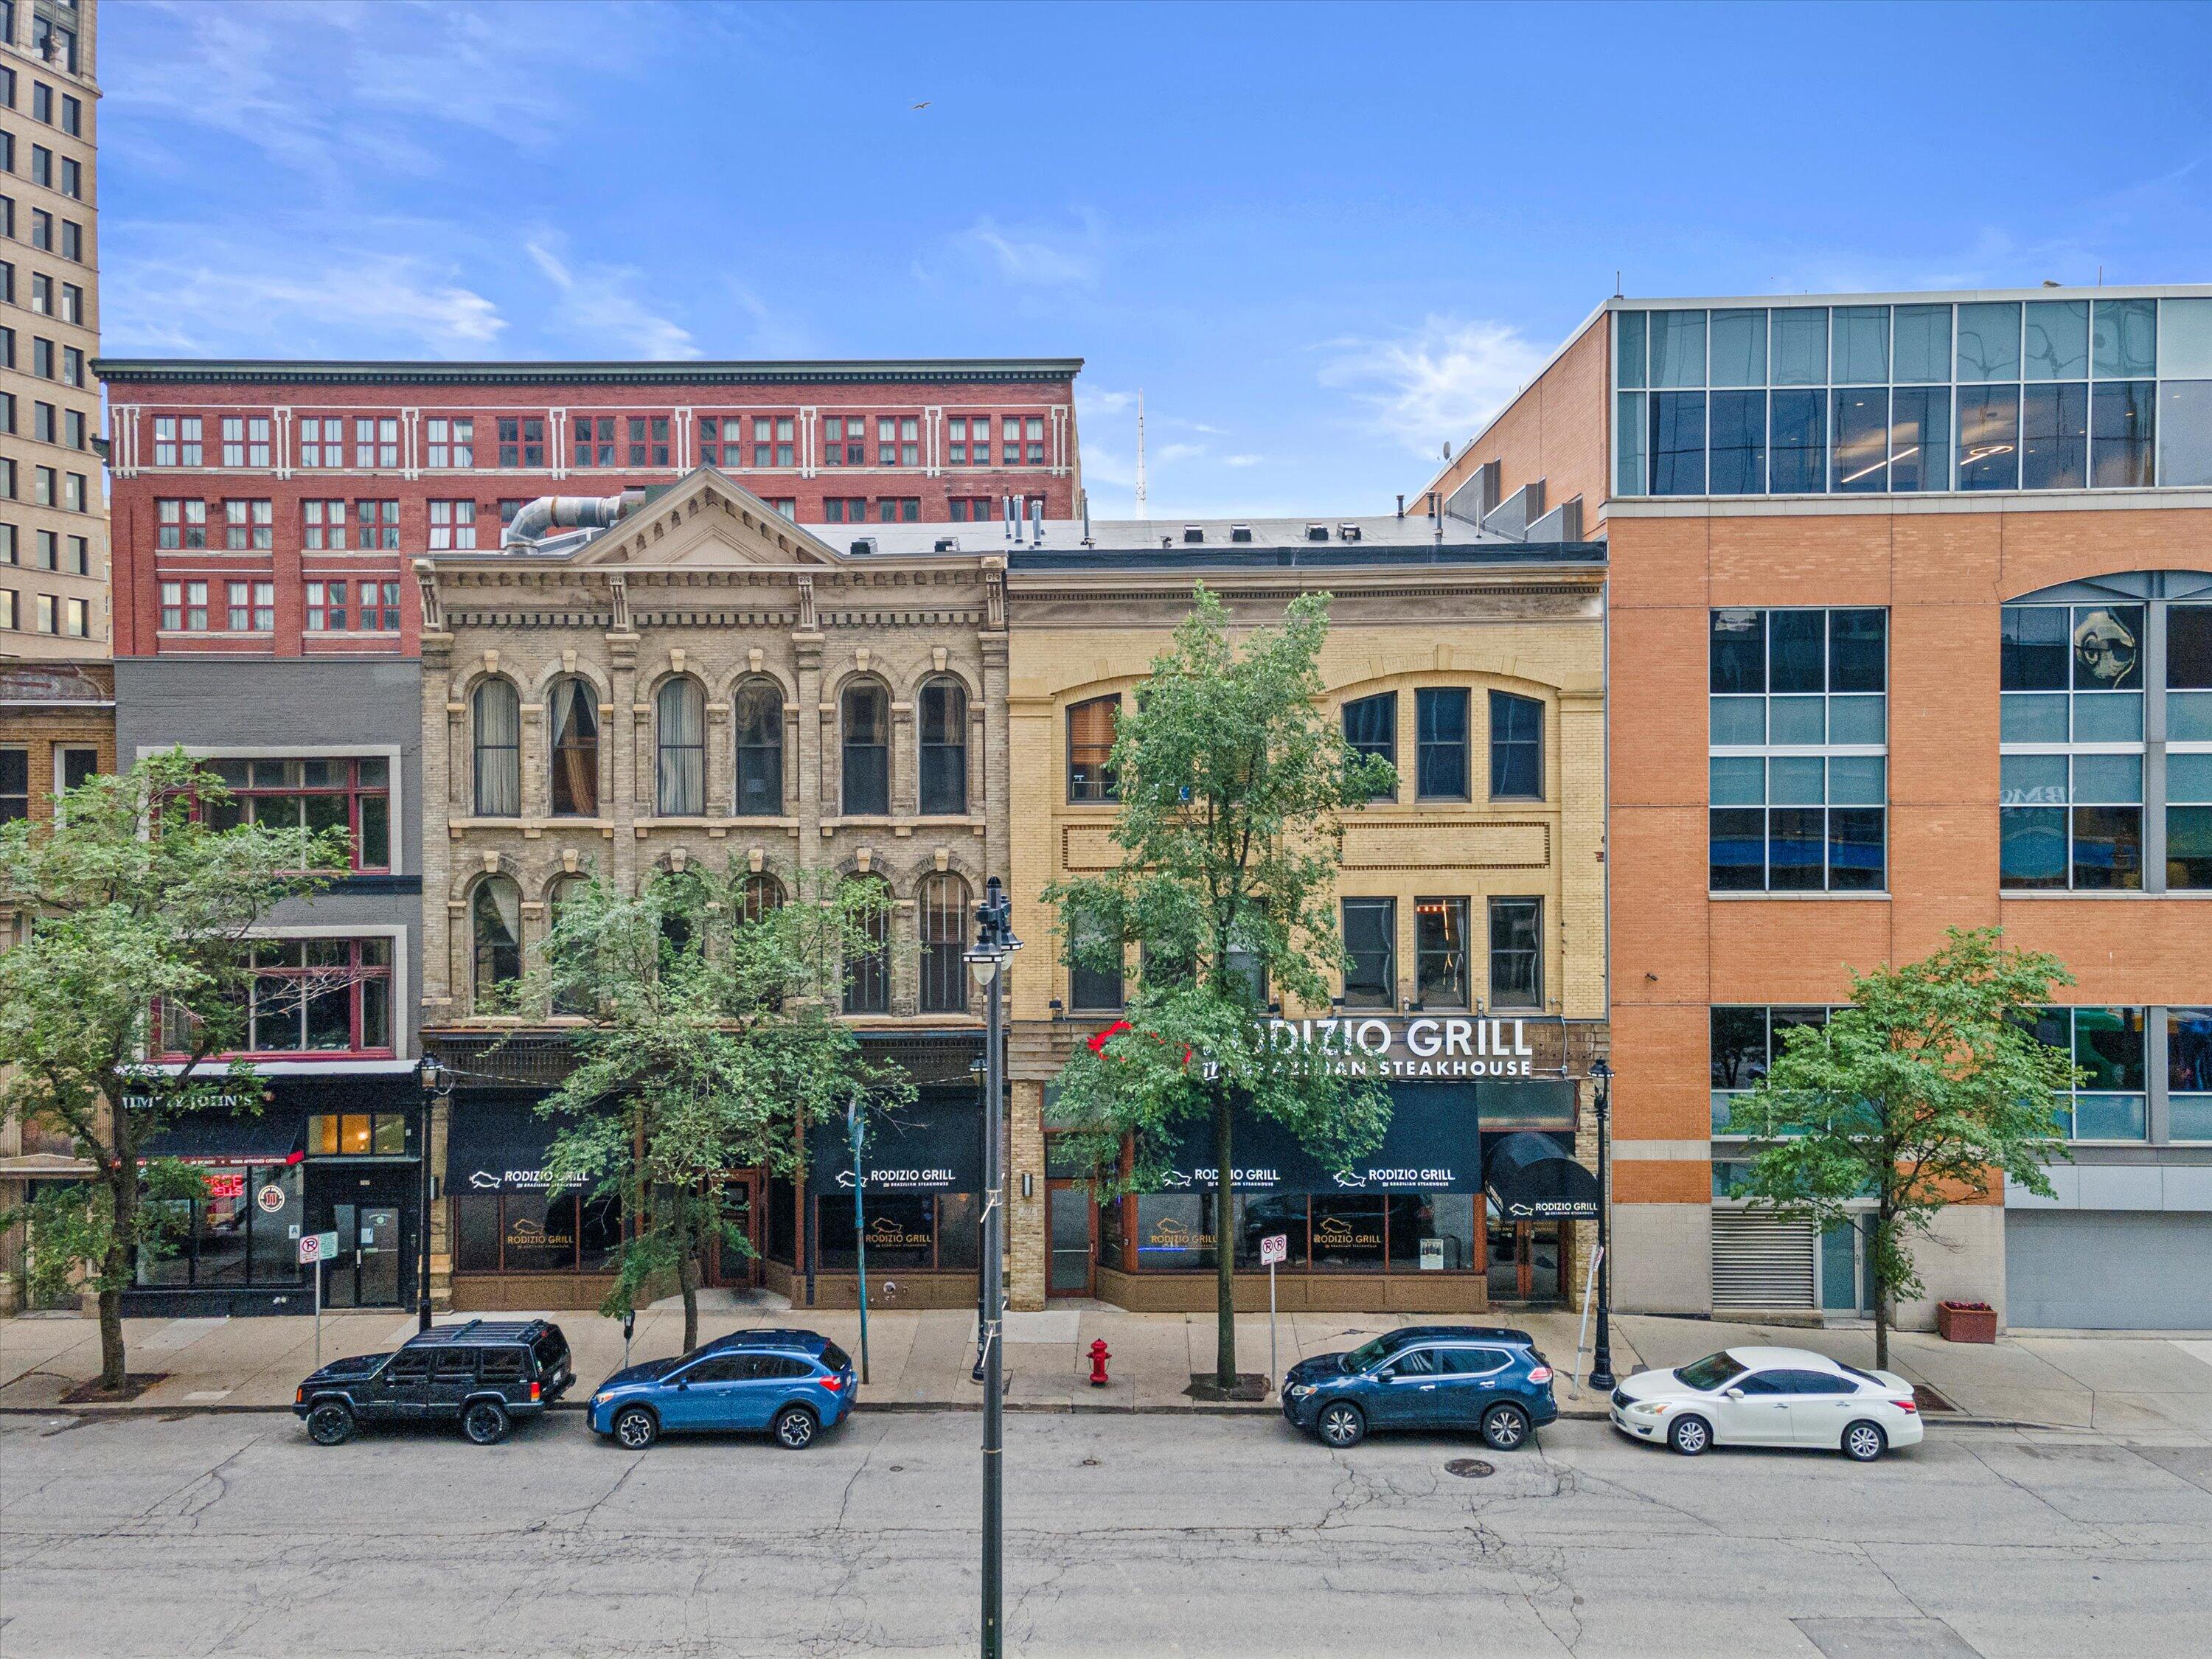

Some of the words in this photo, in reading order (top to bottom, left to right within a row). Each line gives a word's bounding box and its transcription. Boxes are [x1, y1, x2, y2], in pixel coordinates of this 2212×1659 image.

[1407, 1020, 1533, 1057] GRILL
[1380, 1061, 1531, 1077] STEAKHOUSE
[505, 1171, 553, 1181] RODIZIO
[871, 1170, 919, 1181] RODIZIO
[1194, 1169, 1243, 1180] RODIO
[1369, 1169, 1418, 1180] RODIZIO
[1535, 1203, 1571, 1211] RODIZIO
[1573, 1203, 1598, 1211] GRILL
[507, 1236, 546, 1244] RODIZIO
[548, 1236, 574, 1244] GRILL
[865, 1234, 903, 1243] RODIZIO
[906, 1234, 931, 1242] GRILL
[1151, 1235, 1189, 1243] RODIZIO
[1192, 1235, 1217, 1243] GRILL
[1313, 1234, 1353, 1243] RODIZIO
[1356, 1234, 1381, 1243] GRILL
